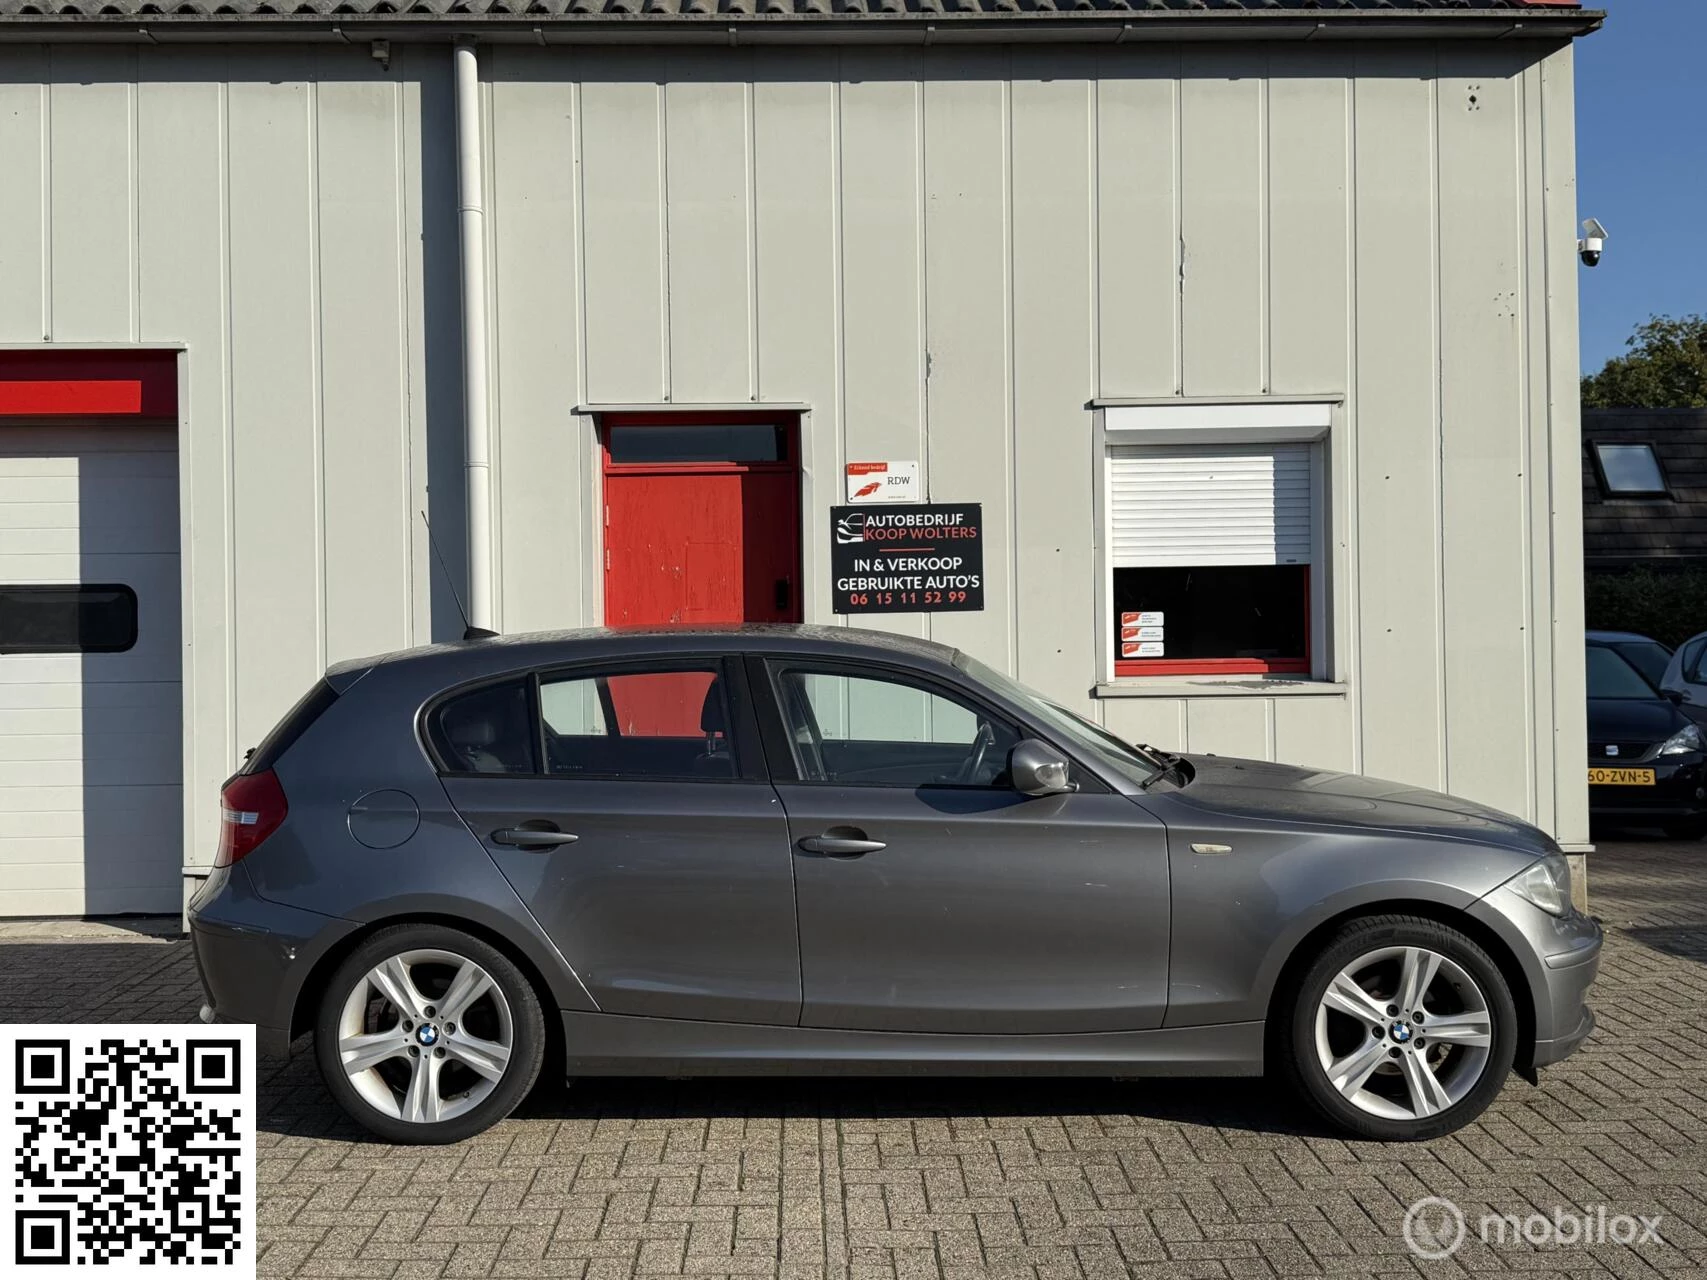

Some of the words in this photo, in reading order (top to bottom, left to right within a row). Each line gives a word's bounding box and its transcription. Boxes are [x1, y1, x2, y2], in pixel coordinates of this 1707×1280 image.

[887, 476, 911, 485] RDW
[866, 513, 964, 527] AUTOBEDRIJF
[866, 528, 907, 541] KOOP
[909, 526, 977, 540] WOLTERS
[854, 559, 870, 572] IN
[873, 559, 885, 572] &
[887, 557, 963, 571] VERKOOP
[837, 576, 922, 591] GEBRUIKTE
[925, 574, 980, 589] AUTO'S
[850, 593, 868, 605] 06
[876, 591, 892, 604] 15
[900, 592, 916, 604] 11
[924, 591, 942, 603] 52
[948, 591, 966, 603] 99
[1588, 770, 1651, 783] 60-ZVN-5
